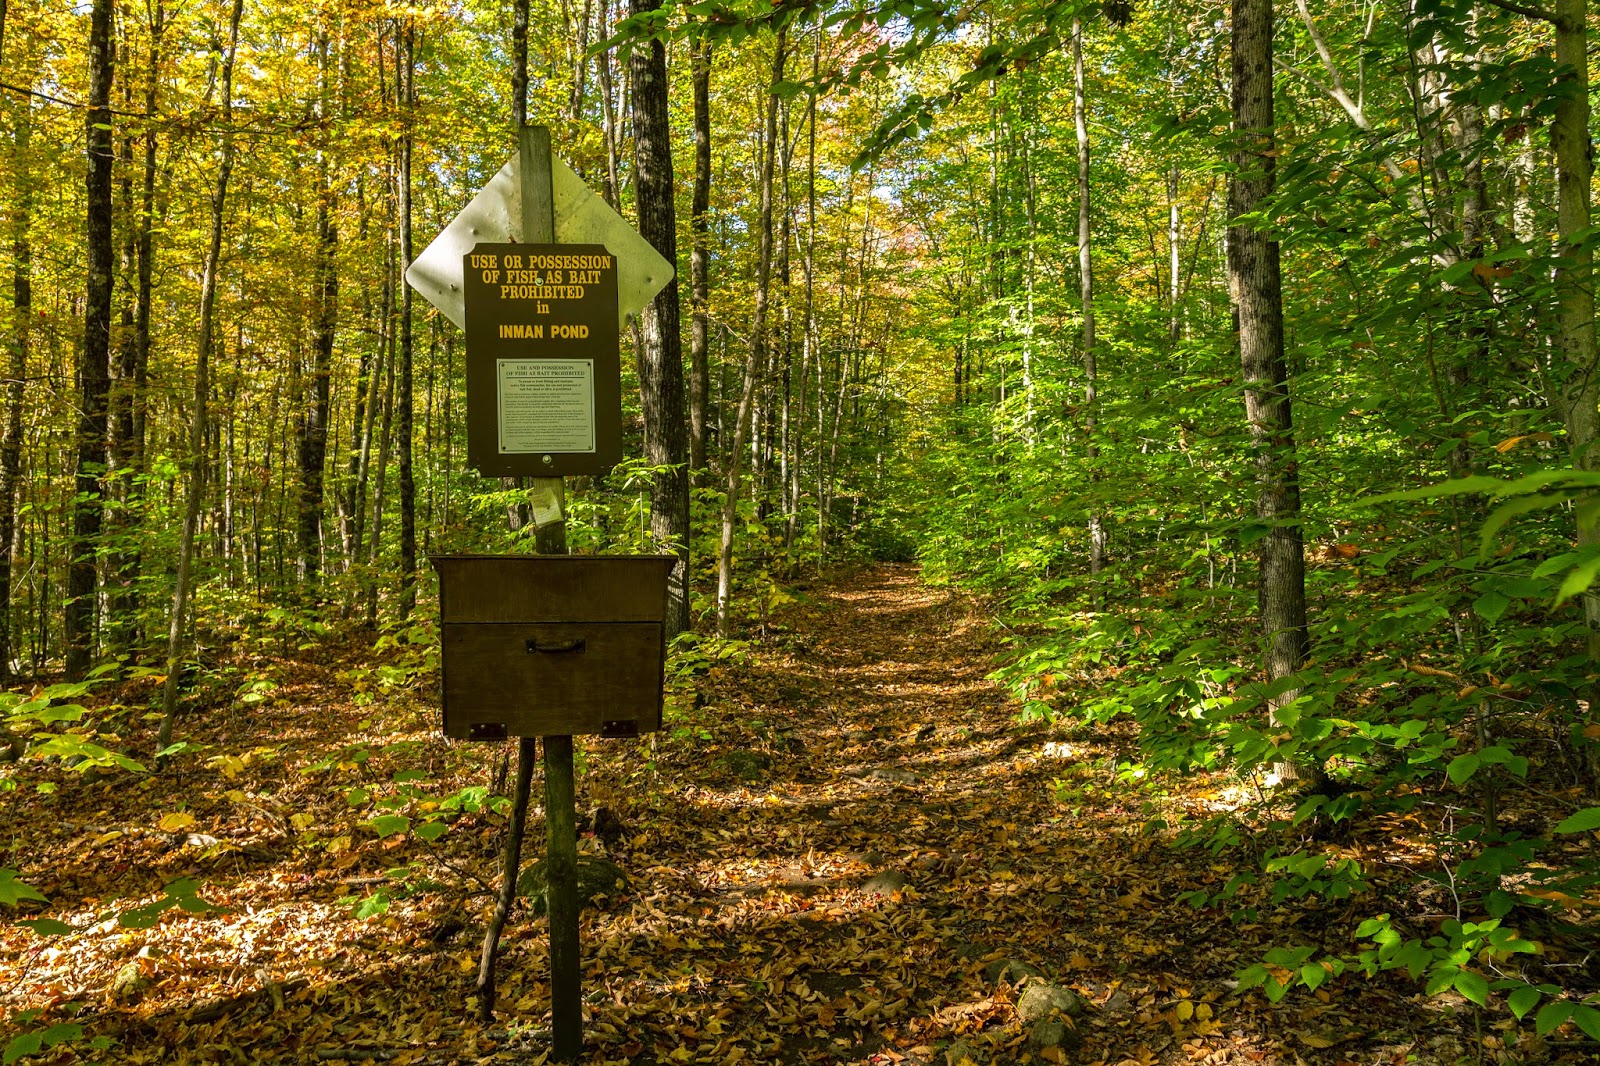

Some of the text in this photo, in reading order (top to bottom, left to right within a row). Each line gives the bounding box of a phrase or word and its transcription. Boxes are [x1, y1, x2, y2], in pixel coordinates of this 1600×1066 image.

[471, 255, 611, 270] USE OR POSSESSION
[482, 270, 601, 285] OF FISH AS BAIT
[500, 285, 585, 299] PROHIBITED
[537, 300, 550, 314] in
[499, 325, 589, 339] INMAN POND
